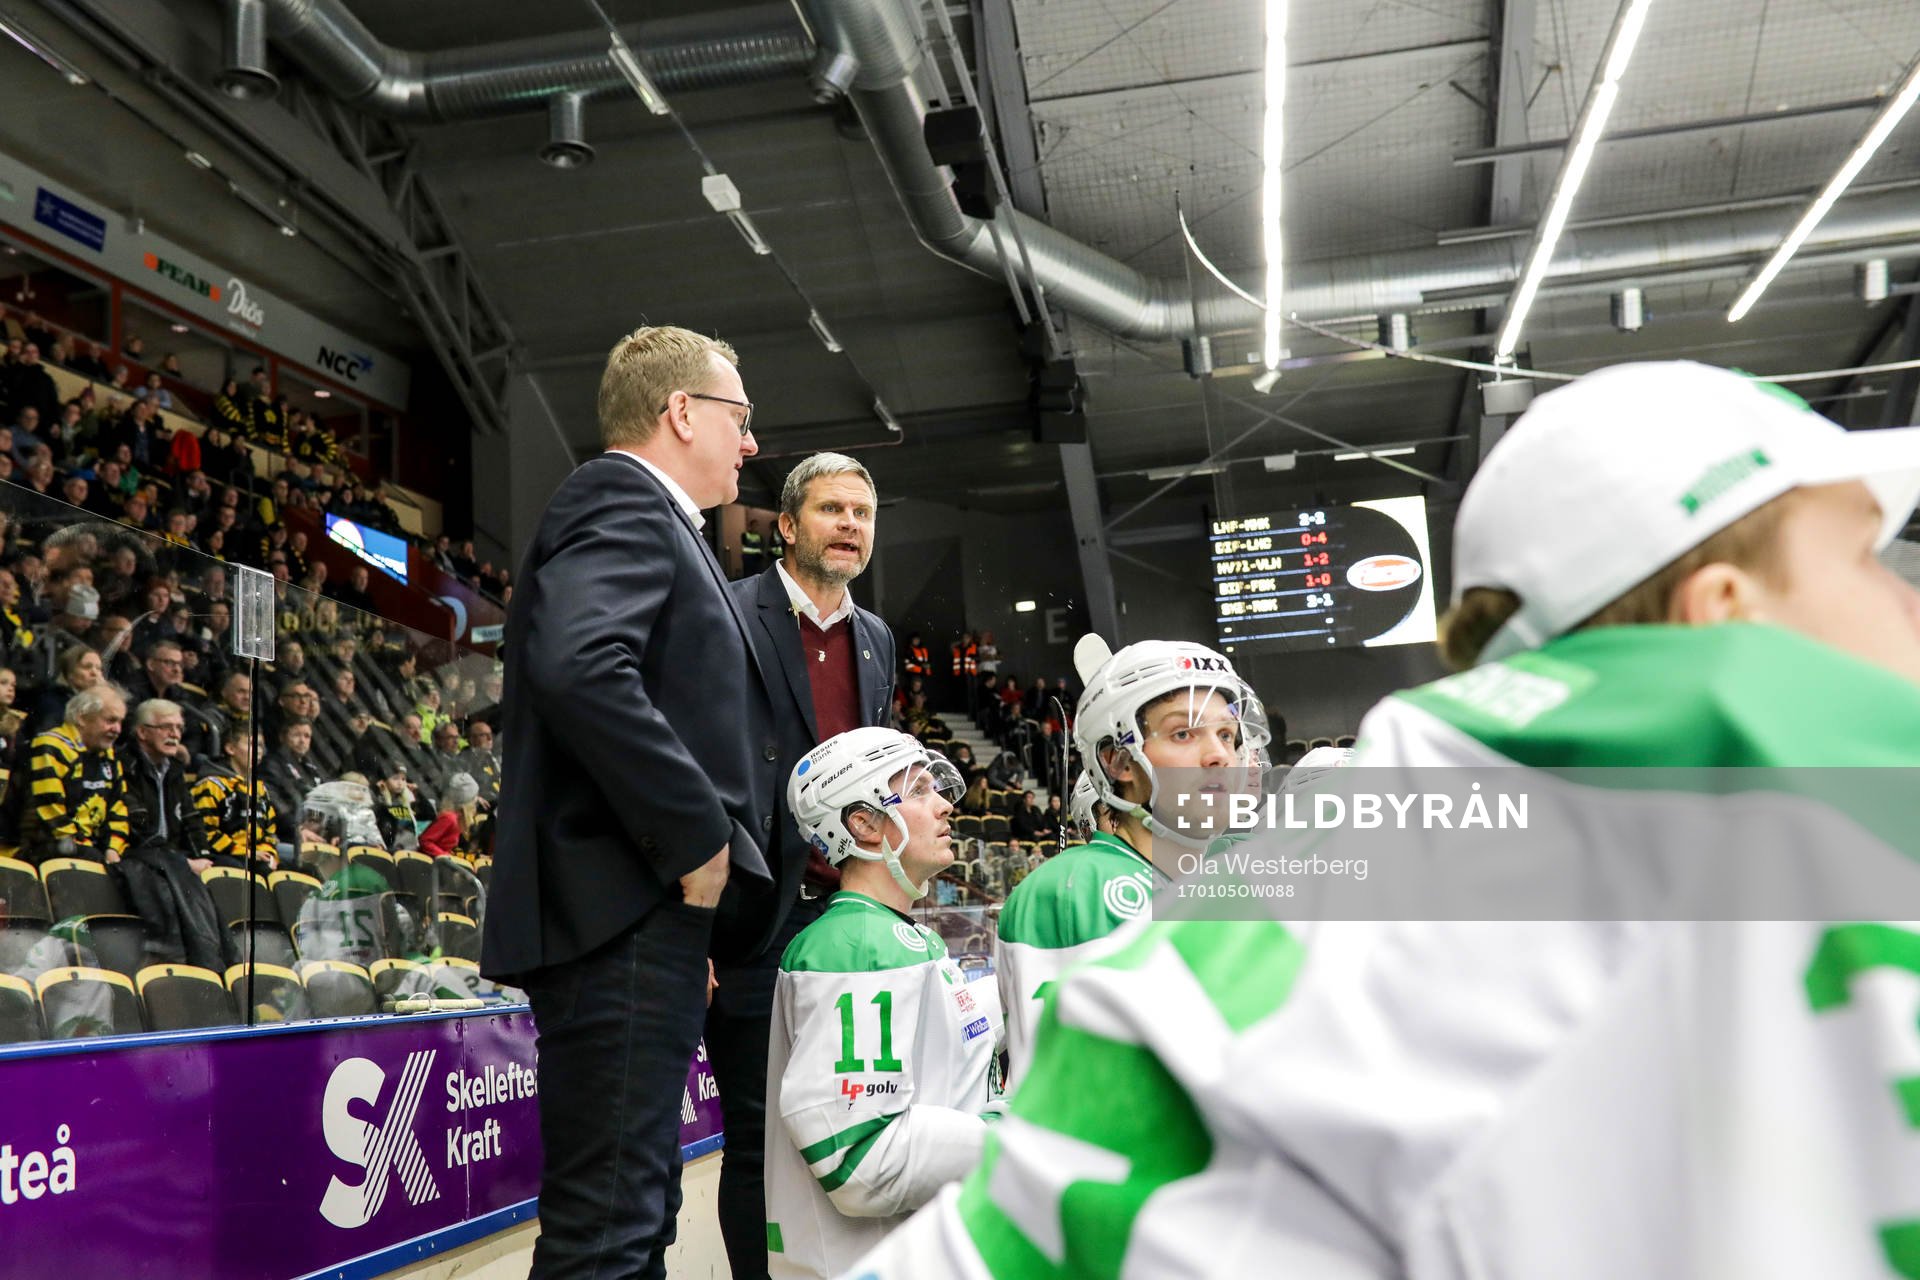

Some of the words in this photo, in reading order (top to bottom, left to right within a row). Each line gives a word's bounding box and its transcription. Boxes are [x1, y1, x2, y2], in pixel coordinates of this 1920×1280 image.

[157, 257, 211, 297] PEAB
[318, 346, 361, 381] NCC
[1300, 532, 1328, 546] 0-4
[1303, 552, 1330, 566] 1-2
[1305, 572, 1331, 587] 1-0
[1045, 608, 1069, 644] E
[837, 837, 849, 856] SHL
[834, 990, 903, 1073] 11
[866, 1080, 898, 1097] golv
[447, 1118, 501, 1169] Kraft
